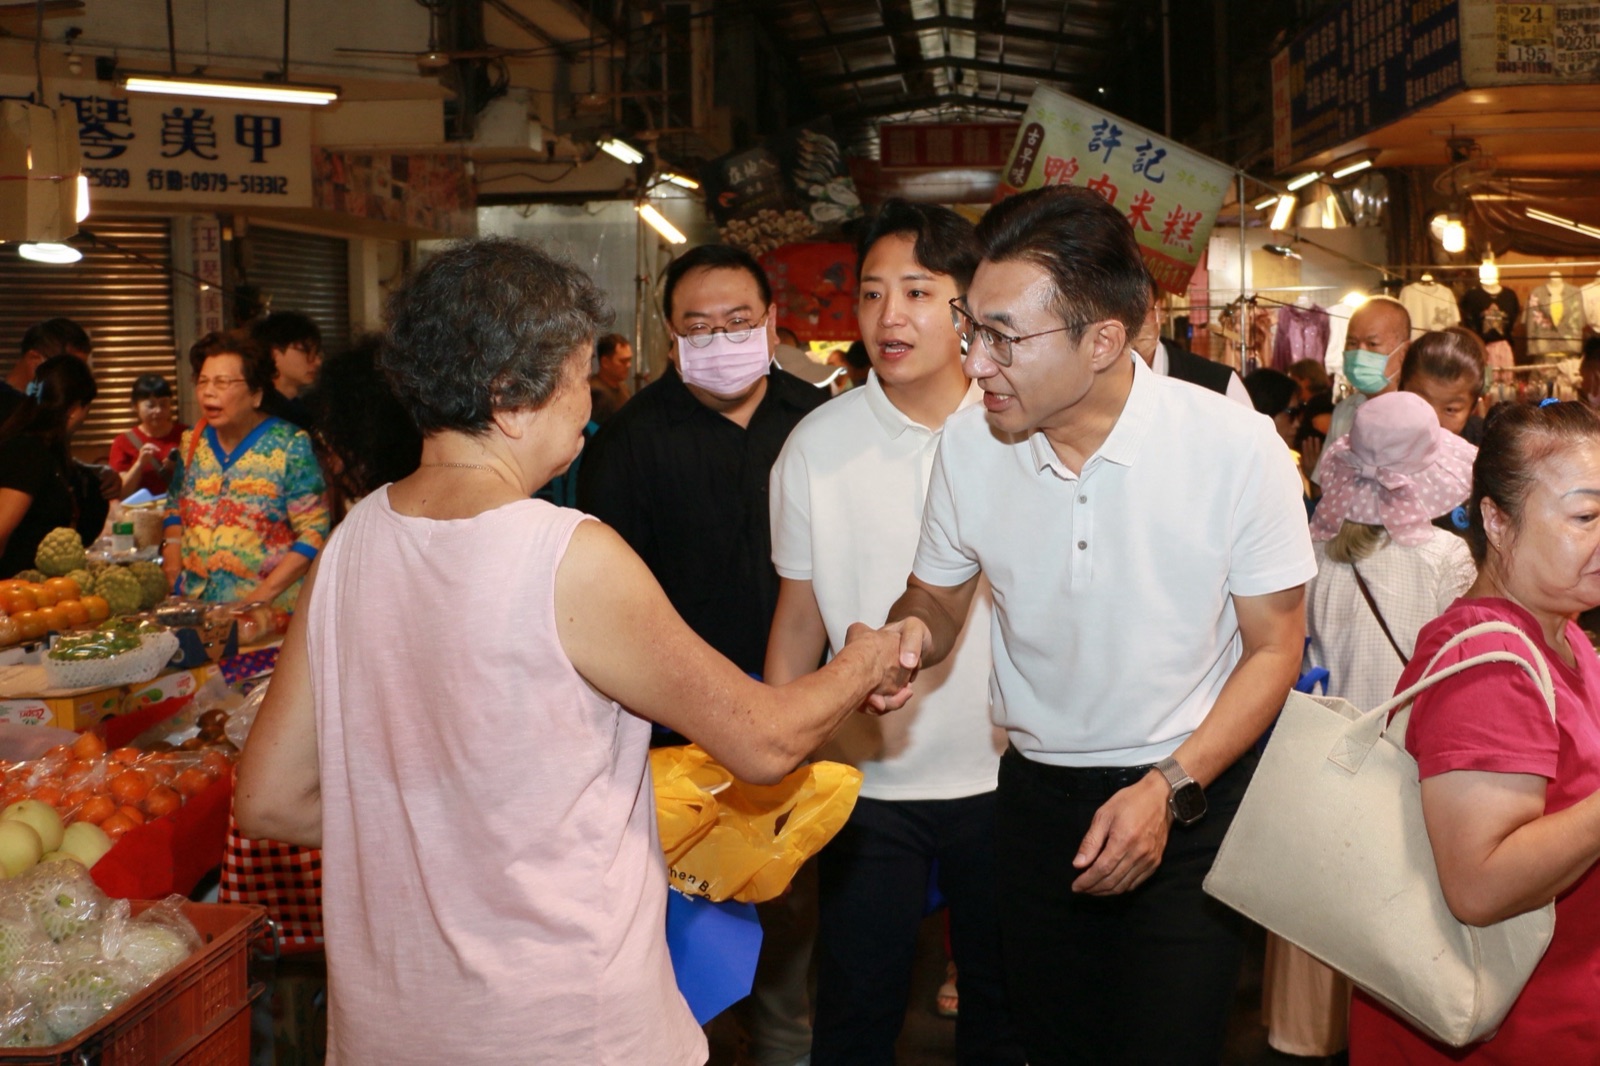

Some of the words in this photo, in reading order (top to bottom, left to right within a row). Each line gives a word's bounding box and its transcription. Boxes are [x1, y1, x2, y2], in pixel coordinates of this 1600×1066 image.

[1520, 7, 1542, 23] 24
[1517, 47, 1546, 61] 195
[0, 93, 281, 163] 琴美甲
[1013, 129, 1041, 185] 古早味
[1089, 119, 1167, 183] 許記
[668, 866, 697, 884] hen
